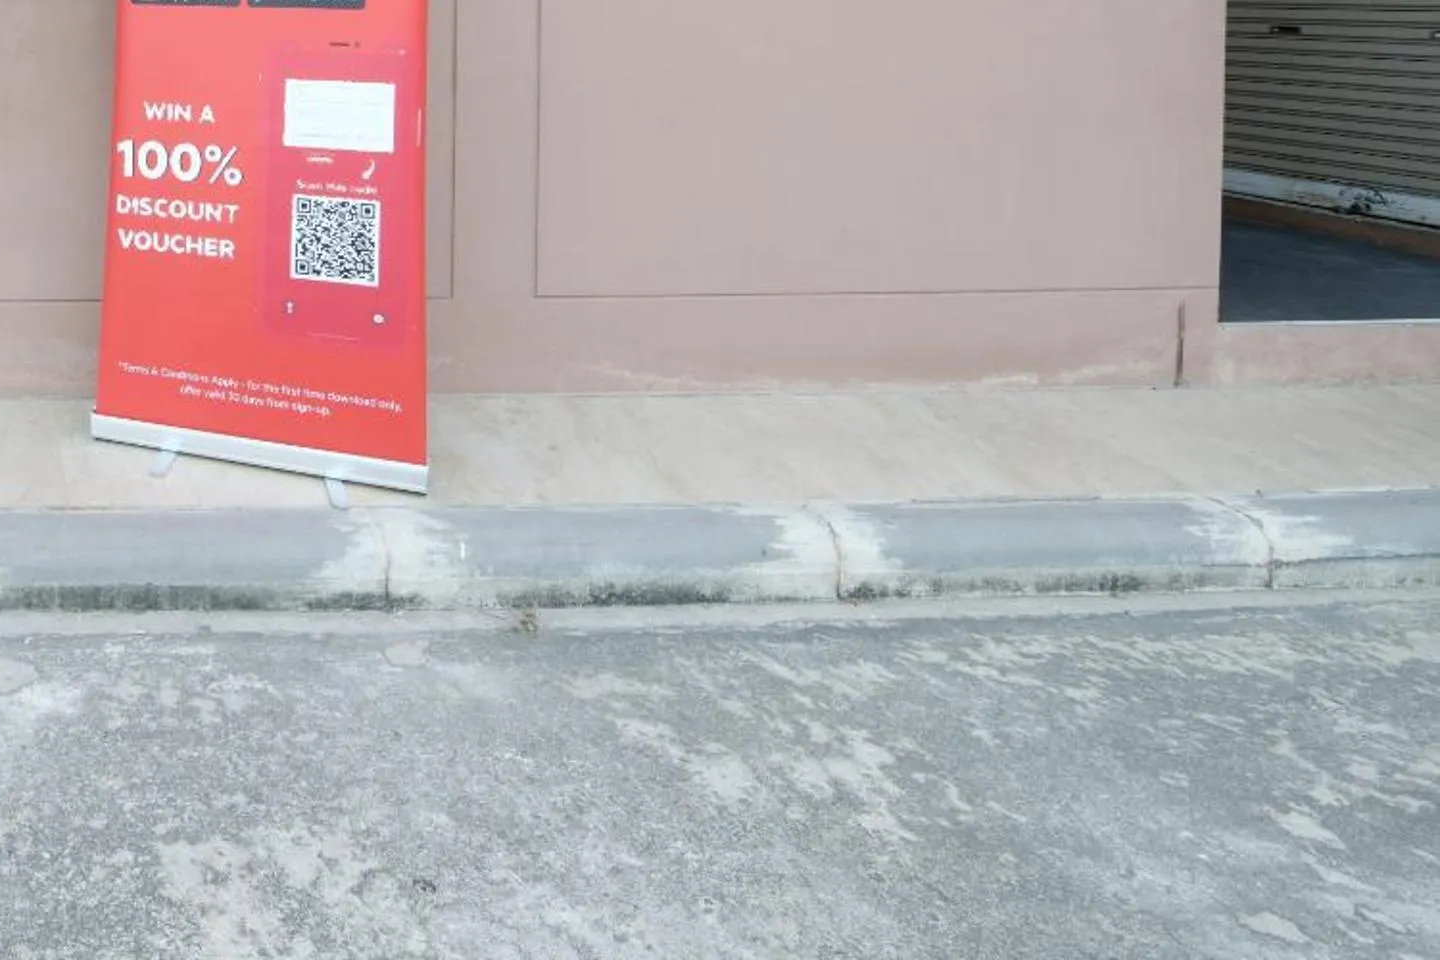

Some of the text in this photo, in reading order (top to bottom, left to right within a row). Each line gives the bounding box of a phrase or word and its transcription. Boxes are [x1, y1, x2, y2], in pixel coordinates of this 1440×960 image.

[144, 102, 215, 123] WIN A
[116, 139, 243, 186] 100%
[116, 194, 239, 224] DISCOUNT
[117, 228, 235, 259] VOUCHER
